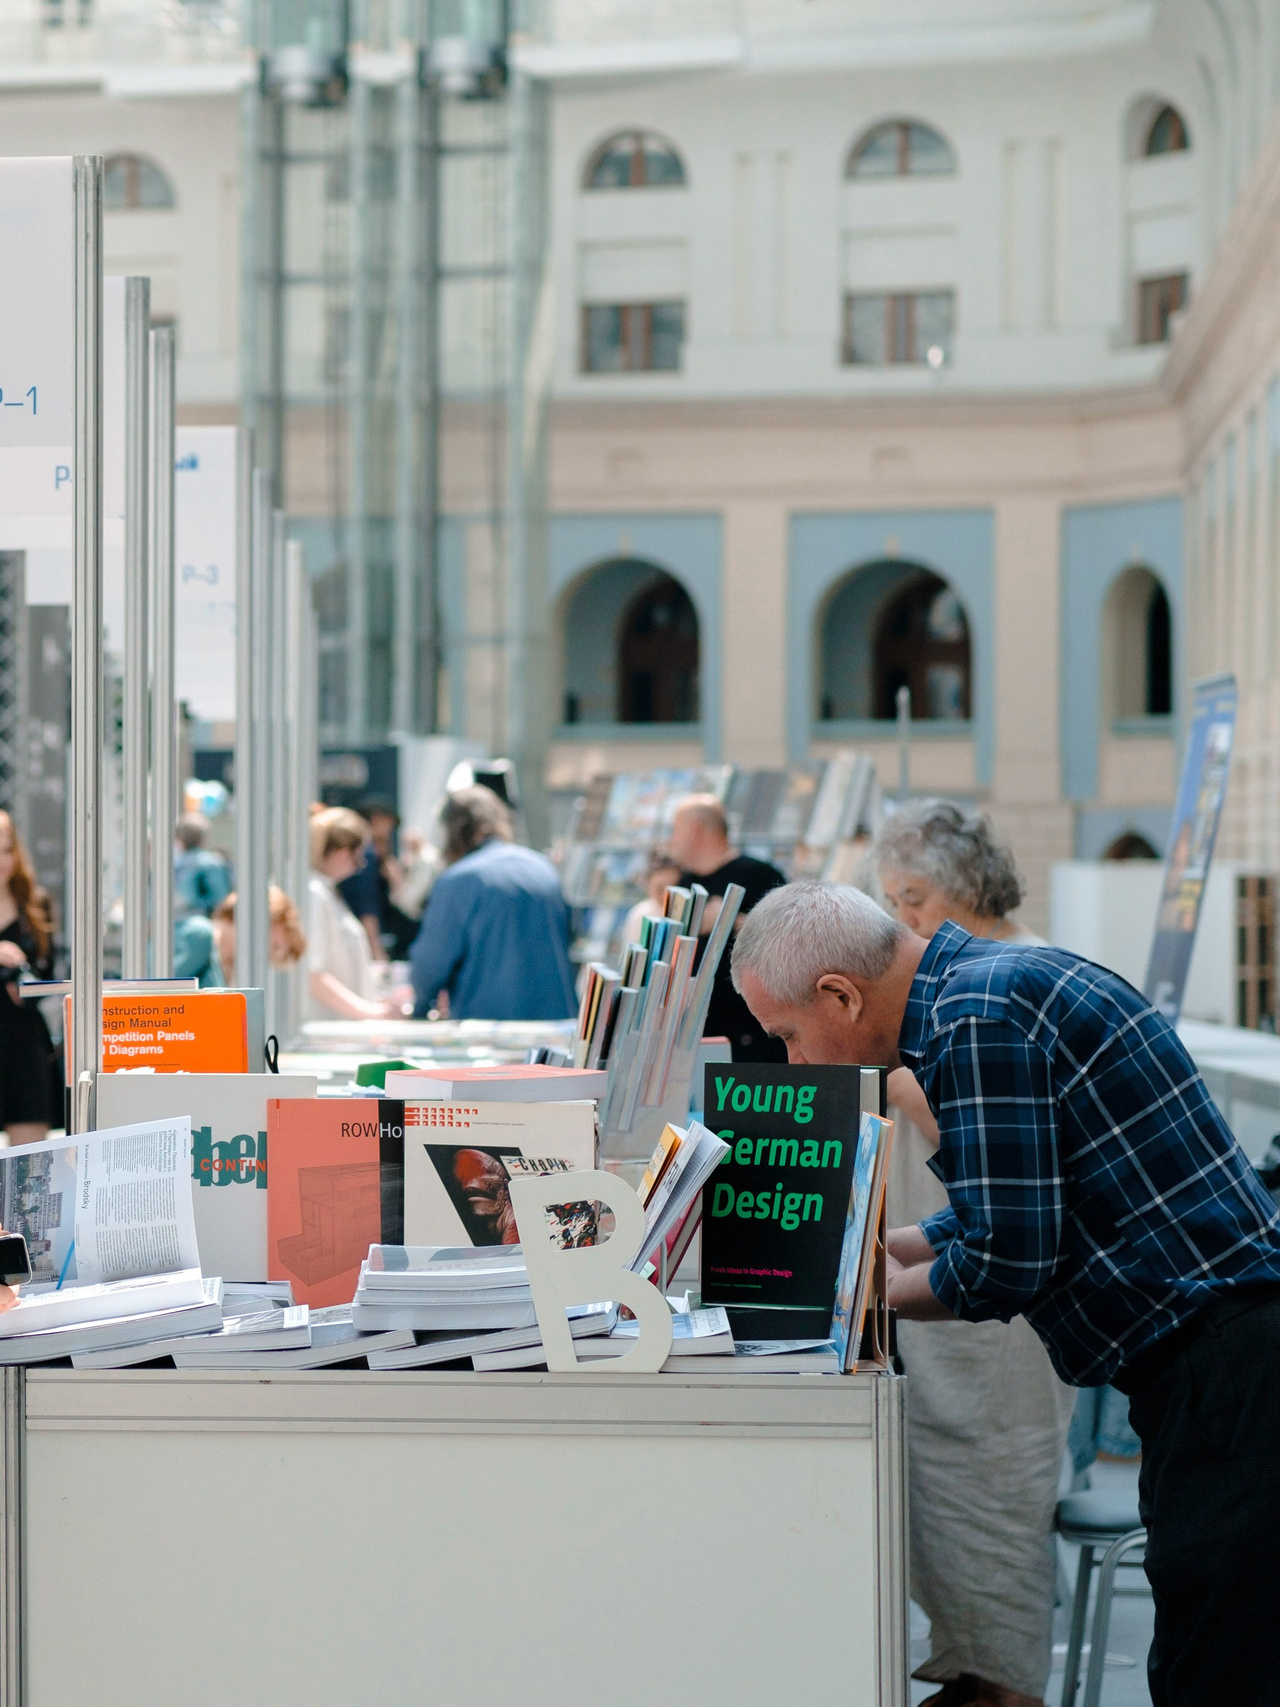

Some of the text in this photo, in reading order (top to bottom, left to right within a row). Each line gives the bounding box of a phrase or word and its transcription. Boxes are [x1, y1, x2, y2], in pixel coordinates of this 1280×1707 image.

[102, 1004, 185, 1016] nstruction and
[102, 1017, 172, 1031] sign Manual
[102, 1030, 196, 1045] mpetition Panels
[109, 1044, 164, 1057] Diagrams
[714, 1076, 818, 1124] Young
[341, 1121, 403, 1138] ROWHo
[714, 1129, 844, 1169] German
[200, 1157, 267, 1173] CONTIN
[517, 1157, 569, 1172] CHOPIN
[81, 1180, 92, 1210] Brodsky
[711, 1181, 824, 1231] Design
[749, 1267, 772, 1277] Graphic
[772, 1268, 793, 1279] Design
